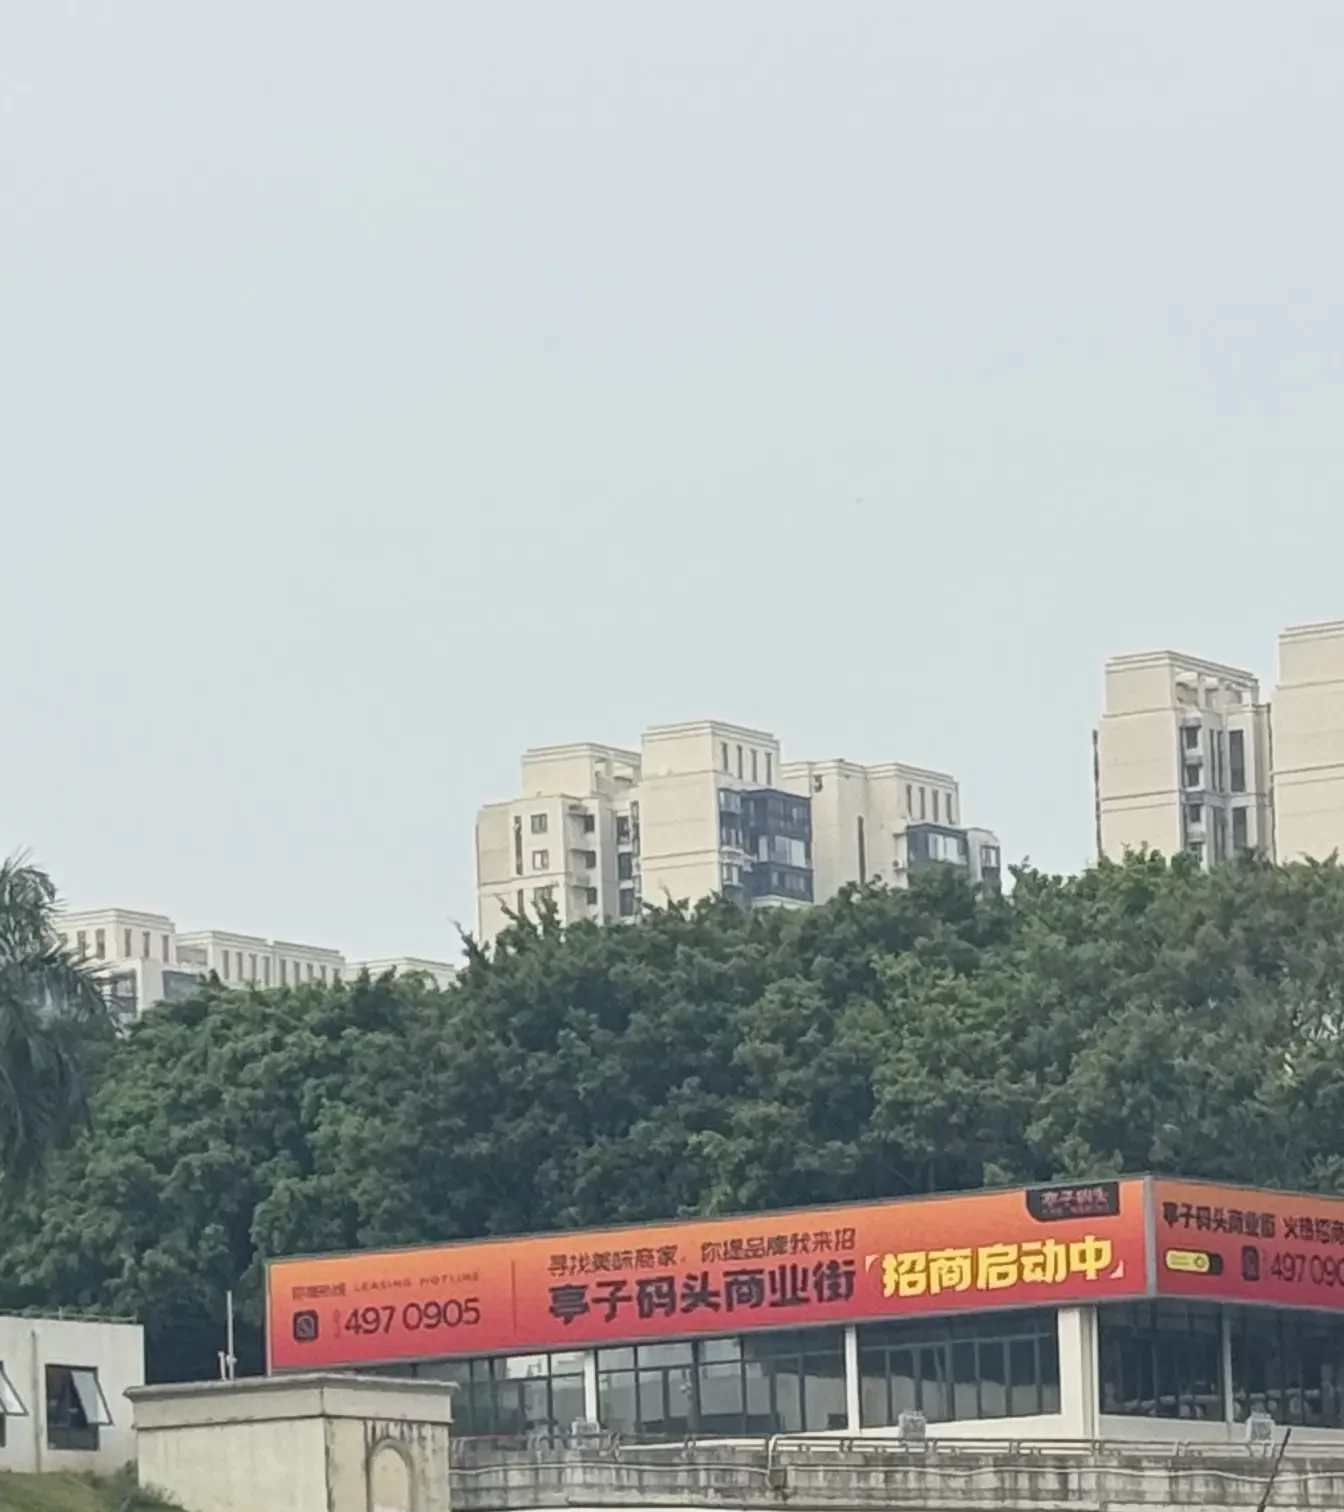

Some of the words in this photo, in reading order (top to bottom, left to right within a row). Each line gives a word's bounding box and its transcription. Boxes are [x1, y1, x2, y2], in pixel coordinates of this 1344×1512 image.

[1270, 1251, 1306, 1282] 497
[547, 1259, 856, 1325] 亭子码头商业街
[344, 1305, 396, 1336] 497
[402, 1297, 481, 1331] 0905
